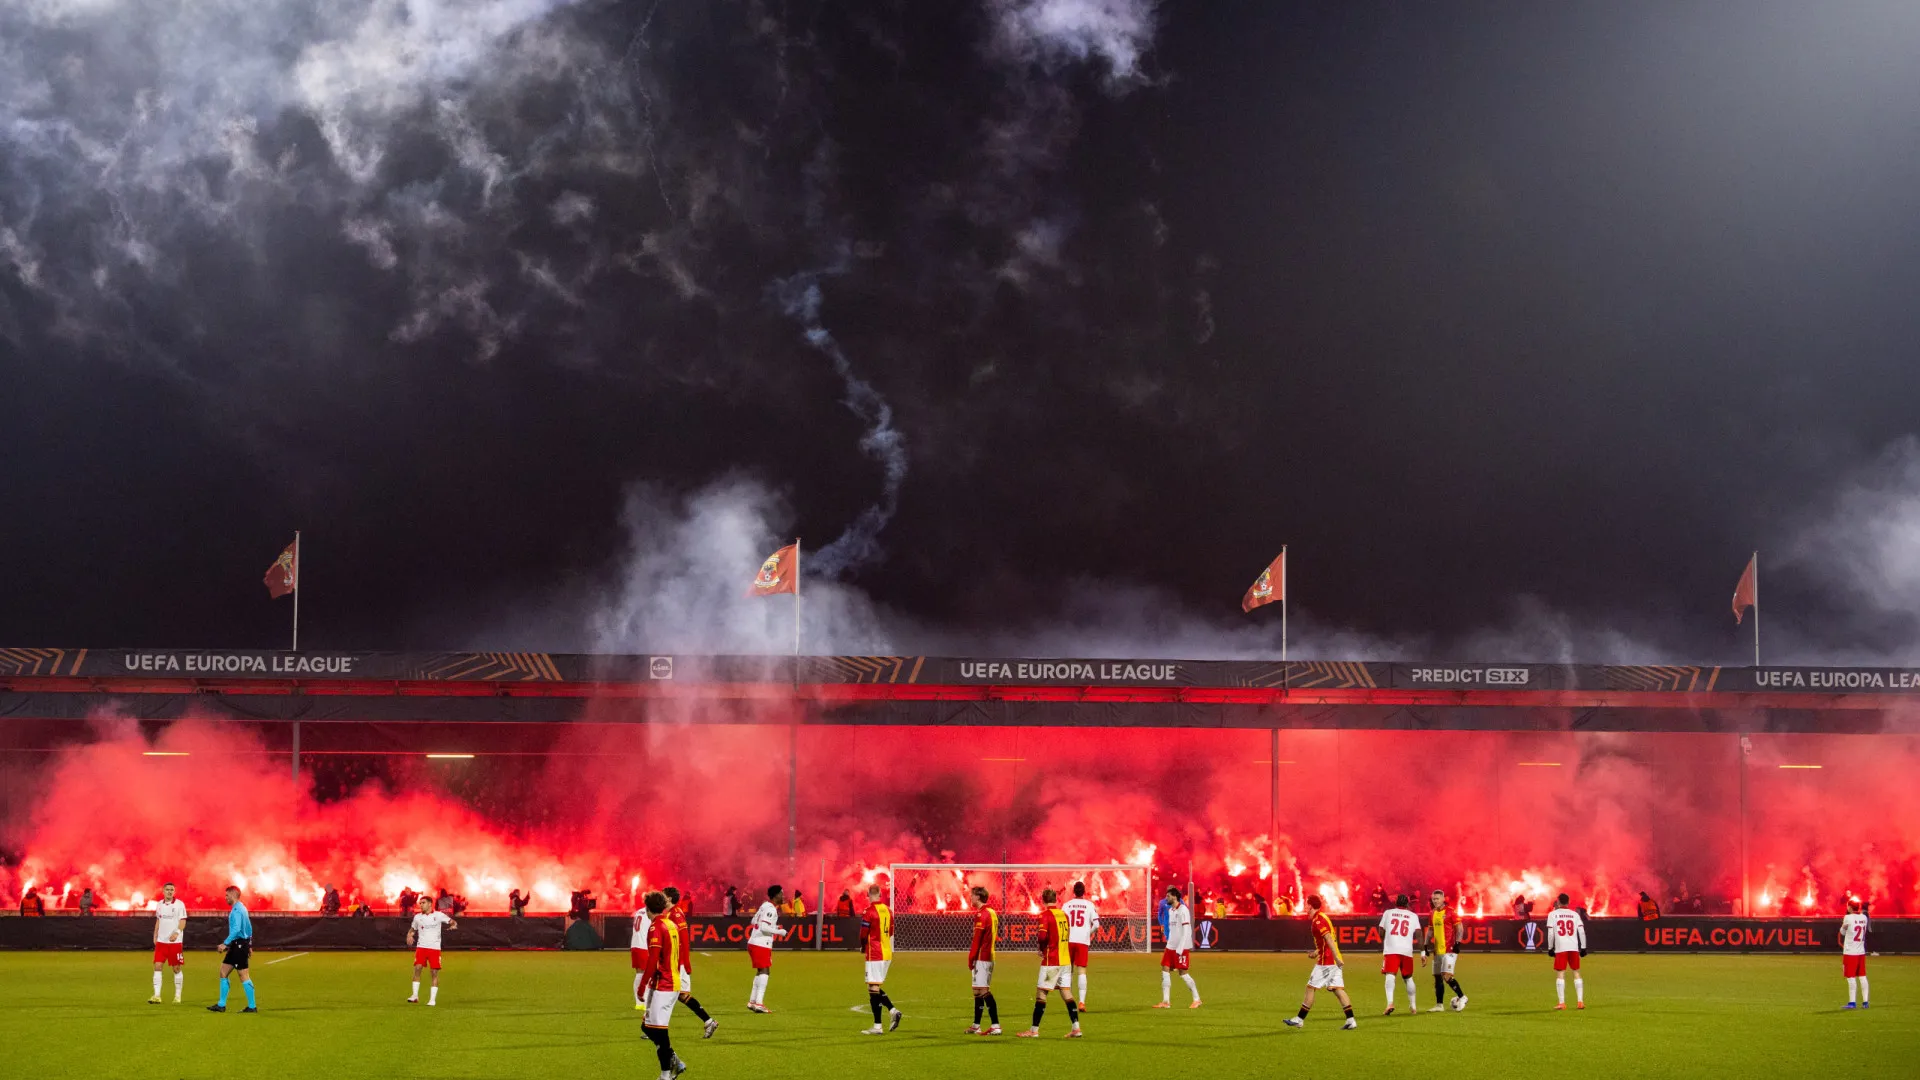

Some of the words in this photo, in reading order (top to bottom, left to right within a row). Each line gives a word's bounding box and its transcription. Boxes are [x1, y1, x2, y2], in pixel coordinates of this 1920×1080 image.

[125, 654, 180, 671] UEFA
[185, 655, 267, 672] EUROPA
[272, 656, 353, 673] LEAGUE
[960, 662, 1013, 678] UEFA
[1018, 663, 1096, 679] EUROPA
[1100, 664, 1176, 680] LEAGUE
[1411, 668, 1483, 683] PREDICT
[1488, 669, 1525, 683] SIX
[1755, 671, 1806, 686] UEFA
[1810, 672, 1885, 688] EUROPA
[1069, 909, 1085, 927] 15
[1390, 918, 1410, 937] 26
[1556, 919, 1575, 937] 39
[1643, 927, 1821, 947] UEFA.COM/UEL
